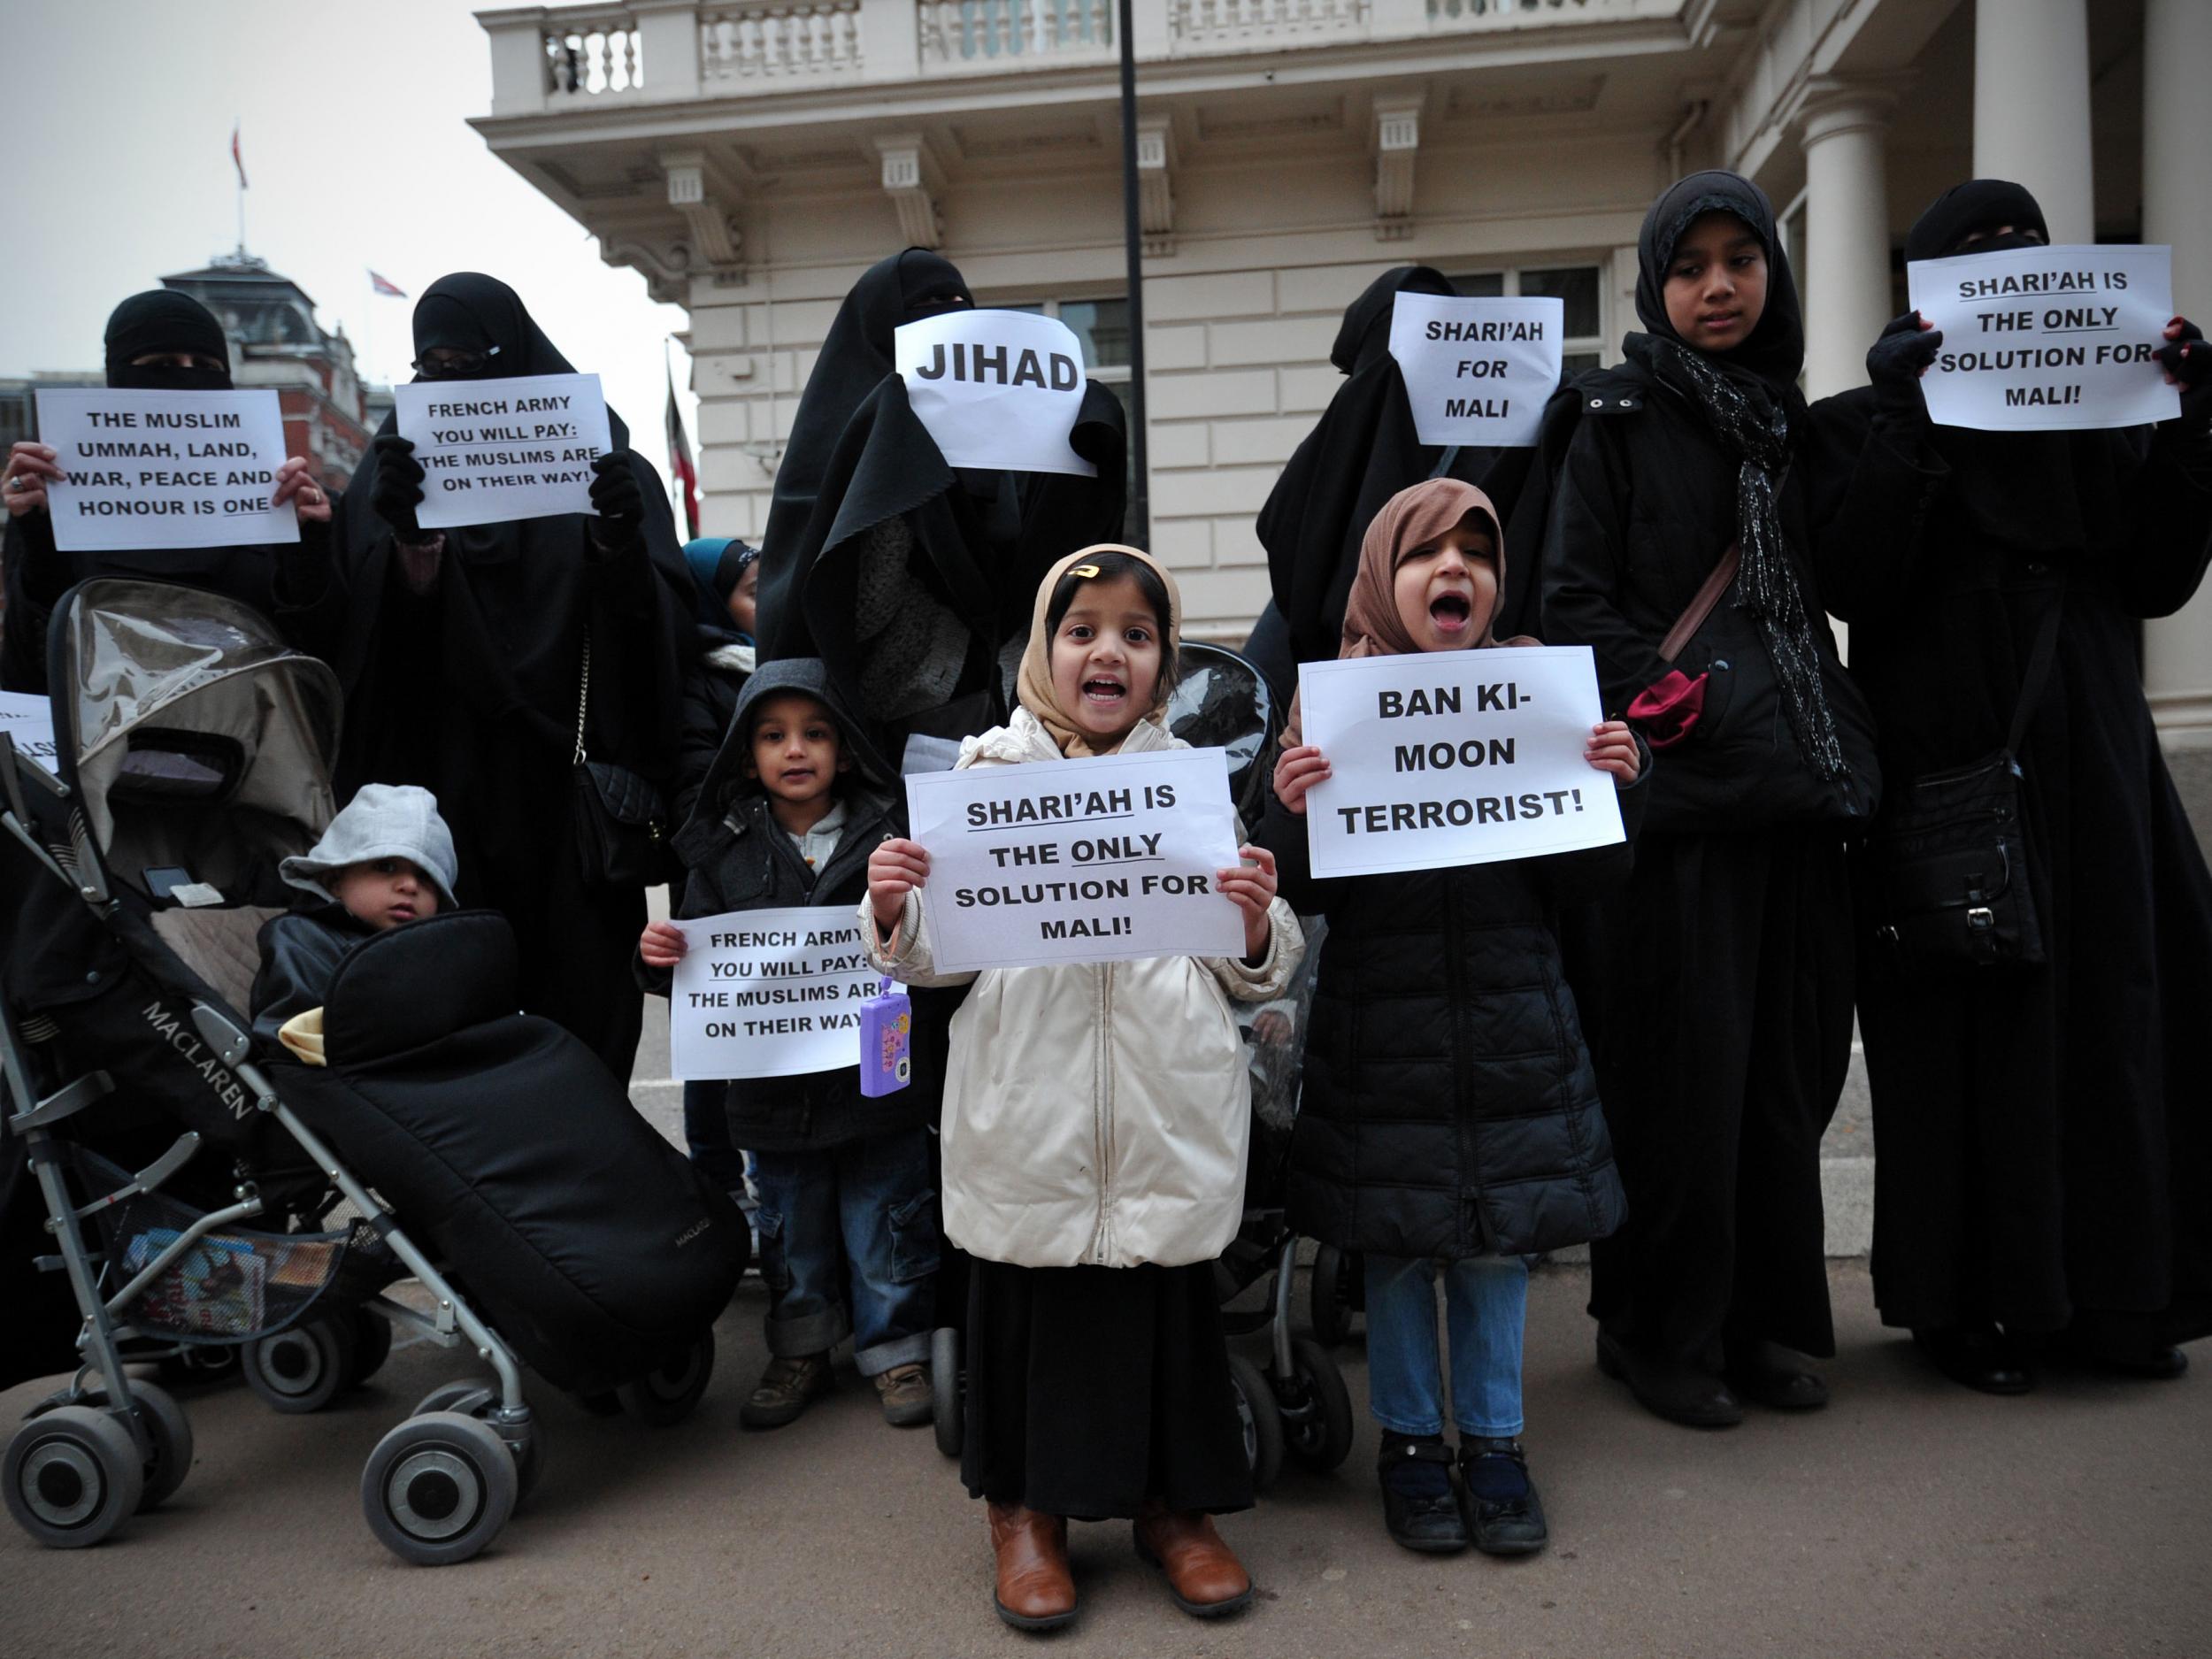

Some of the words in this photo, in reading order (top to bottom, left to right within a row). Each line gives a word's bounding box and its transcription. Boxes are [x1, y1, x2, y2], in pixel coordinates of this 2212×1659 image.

[1958, 272, 2095, 298] SHARI’AH
[2103, 272, 2128, 290] IS
[1425, 320, 1543, 342] SHARI’AH
[1977, 311, 2033, 333] THE
[2043, 307, 2118, 330] ONLY
[915, 342, 1079, 392] JIHAD
[1939, 347, 2085, 373] SOLUTION
[2095, 342, 2152, 365] FOR
[1456, 360, 1508, 379] FOR
[428, 400, 508, 418] FRENCH
[515, 396, 572, 413] ARMY
[2005, 385, 2082, 406] MALI!
[87, 411, 137, 428] THE
[145, 413, 241, 429] MUSLIM
[1445, 399, 1509, 419] MALI
[432, 428, 474, 443] YOU
[479, 426, 528, 441] WILL
[534, 422, 578, 438] PAY:
[77, 442, 180, 460] UMMAH,
[188, 442, 258, 459] LAND,
[419, 453, 459, 469] THE
[465, 449, 556, 466] MUSLIMS
[562, 446, 601, 462] ARE
[66, 471, 133, 490] WAR,
[139, 471, 219, 487] PEACE
[226, 471, 273, 487] AND
[442, 477, 472, 491] ON
[477, 473, 536, 488] THEIR
[541, 470, 590, 484] WAY!
[79, 499, 184, 516] HONOUR
[193, 499, 215, 516] IS
[224, 496, 269, 513] ONE
[1378, 686, 1461, 719] BAN
[1477, 682, 1531, 712] KI-
[1394, 738, 1515, 772] MOON
[966, 788, 1132, 826] SHARI’AH
[1143, 785, 1177, 809] IS
[1337, 788, 1584, 834] TERRORIST!
[988, 843, 1060, 867] THE
[1071, 833, 1163, 862] ONLY
[955, 878, 1129, 908] SOLUTION
[1141, 874, 1210, 895] FOR
[1041, 916, 1133, 940] MALI!
[710, 932, 796, 949] FRENCH
[710, 961, 752, 978] YOU
[761, 959, 813, 975] WILL
[821, 954, 868, 972] PAY:
[688, 992, 729, 1009] THE
[737, 984, 840, 1006] MUSLIMS
[704, 1021, 736, 1037] ON
[743, 1016, 812, 1034] THEIR
[142, 1001, 254, 1120] MACLAREN
